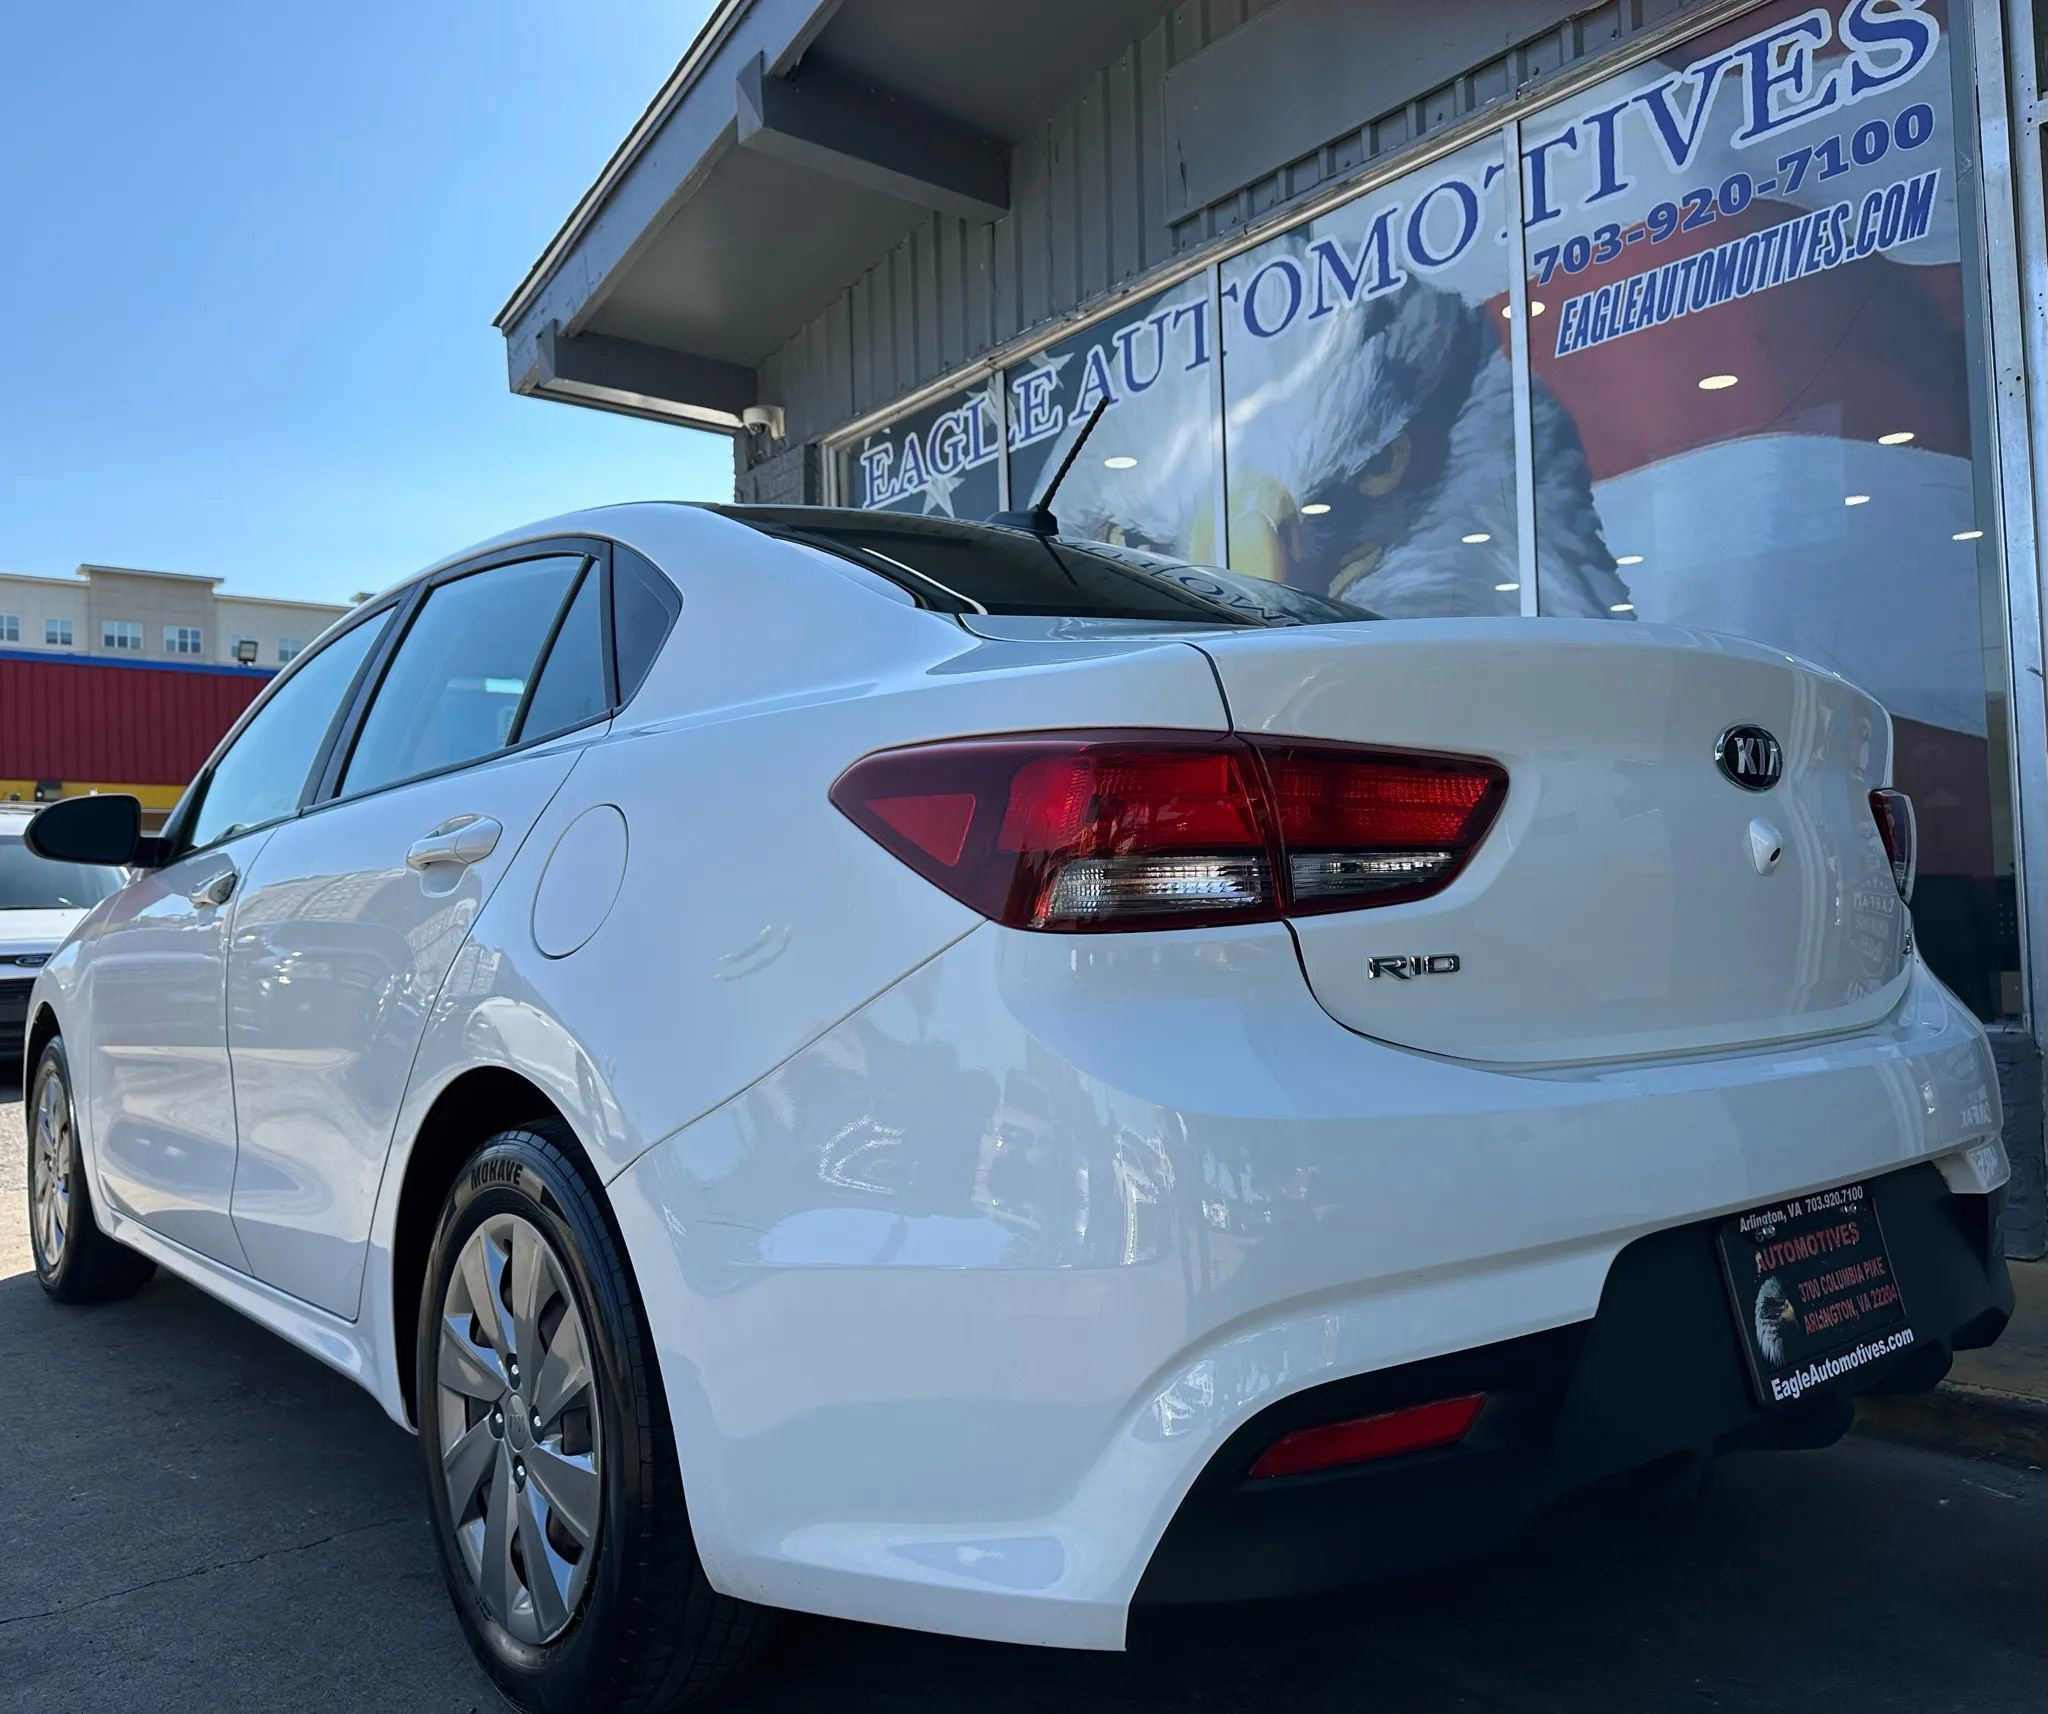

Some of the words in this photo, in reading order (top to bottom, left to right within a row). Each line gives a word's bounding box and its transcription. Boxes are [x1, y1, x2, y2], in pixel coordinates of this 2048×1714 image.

[1533, 103, 1935, 286] 703-920-7100
[861, 367, 1061, 508] EAGLE
[1070, 0, 1937, 425] AUTOMOTIVES
[1556, 170, 1940, 357] EAGLEAUTOMOTIVES.COM
[1734, 737, 1781, 777] KIA
[1367, 955, 1461, 981] RIO
[1787, 1201, 1803, 1219] VA
[1805, 1185, 1864, 1214] 703.920.7100
[1755, 1221, 1861, 1274] AUTOMOTIVES
[1798, 1278, 1821, 1303] 3700
[1820, 1263, 1866, 1295] COLUMBIA
[1863, 1256, 1886, 1280] PIKE
[1856, 1292, 1873, 1314] VA
[1770, 1327, 1915, 1402] EagleAutomotives.com
